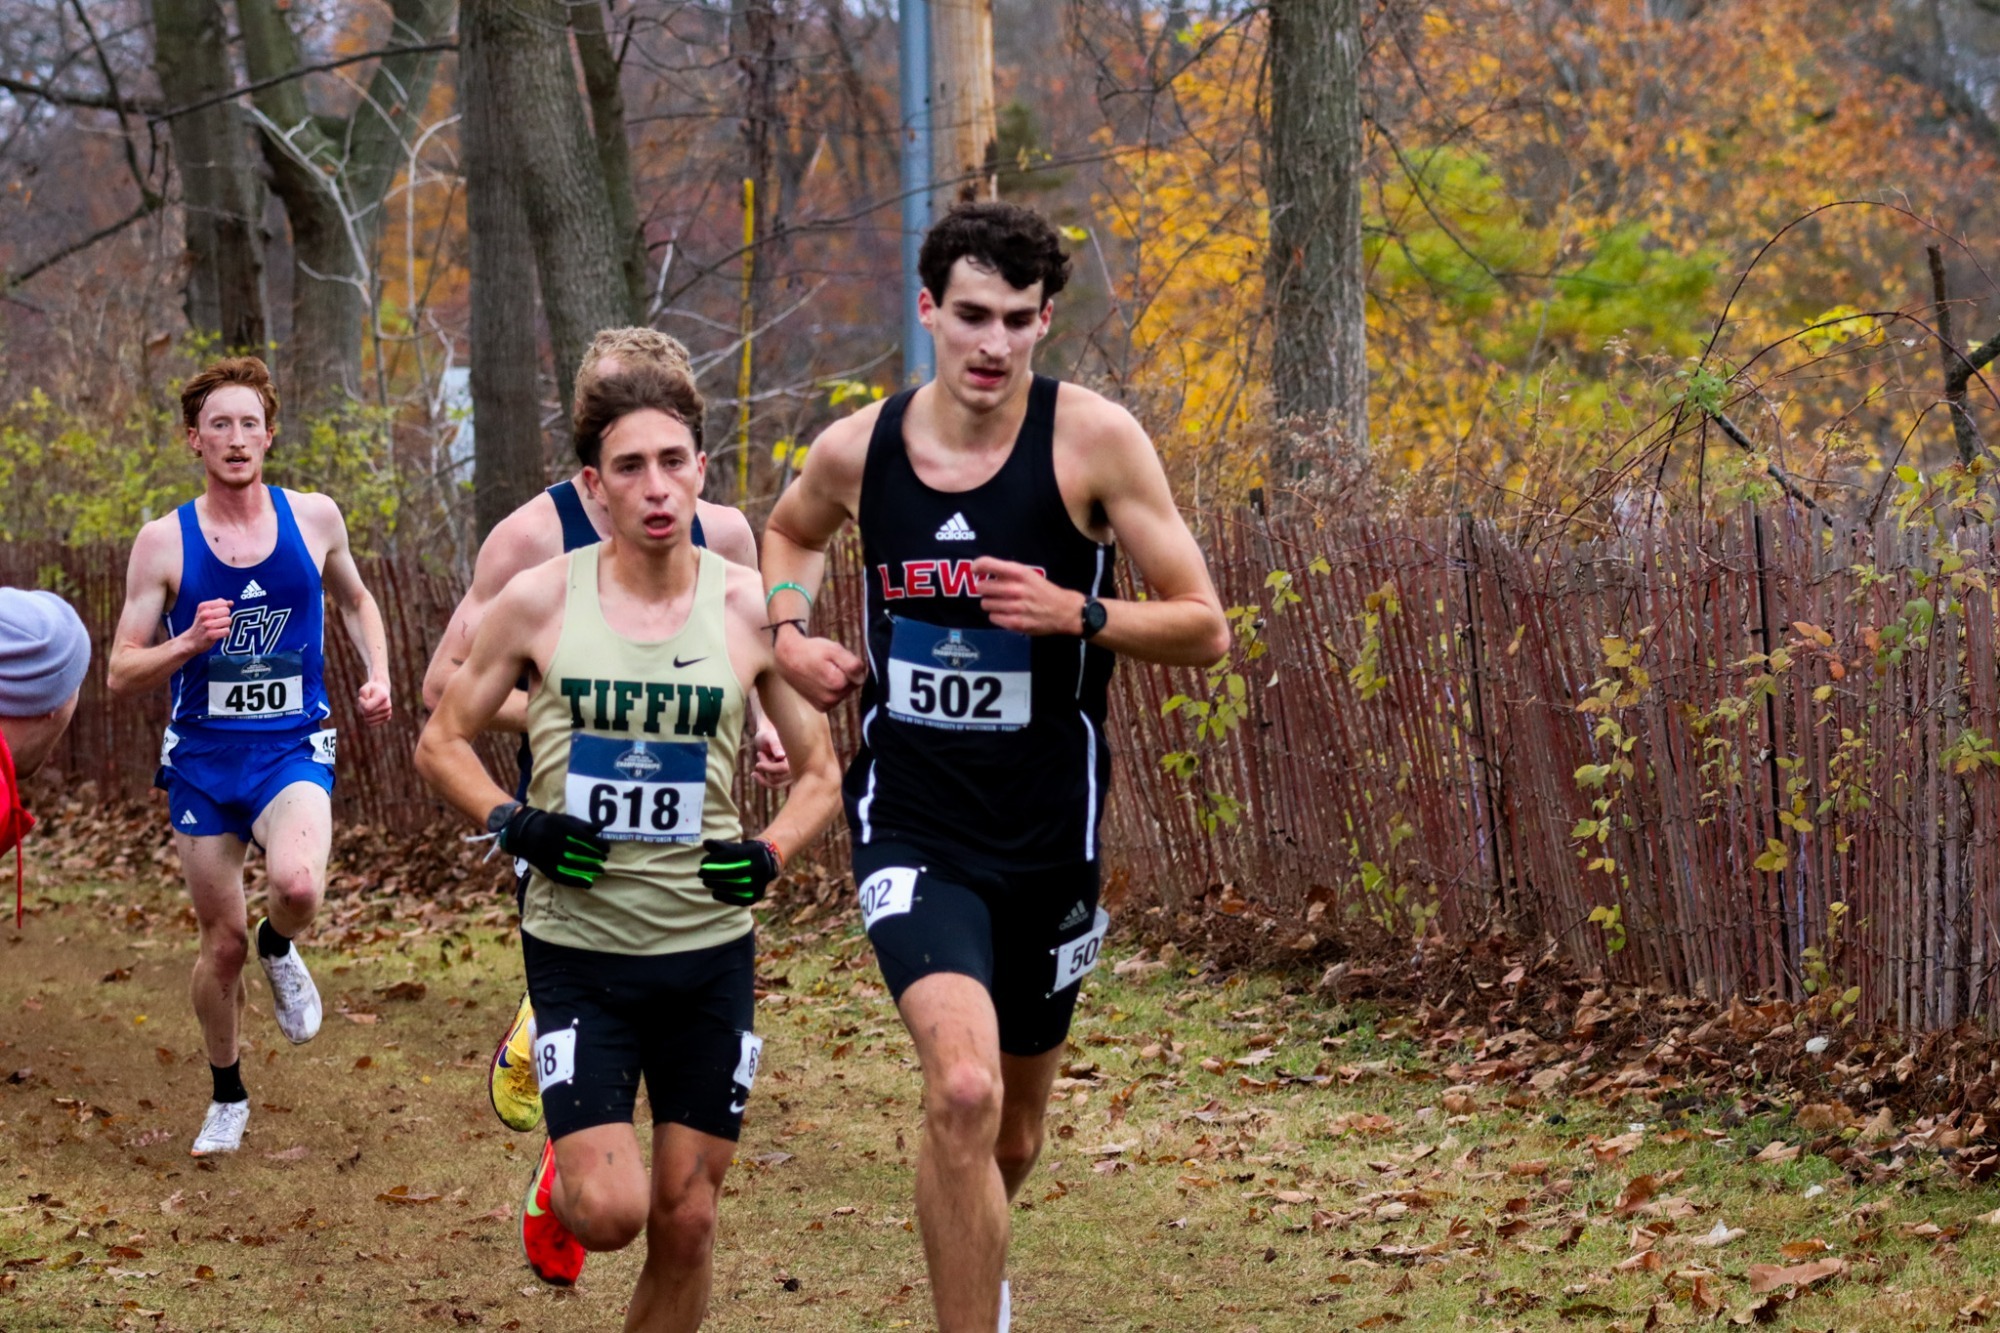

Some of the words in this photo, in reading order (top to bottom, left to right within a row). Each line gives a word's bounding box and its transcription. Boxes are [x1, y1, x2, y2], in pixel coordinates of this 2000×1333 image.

[935, 530, 976, 541] adidas
[240, 590, 267, 600] adidas
[877, 559, 1046, 600] LEW
[221, 605, 292, 656] GV
[225, 682, 287, 712] 450
[561, 678, 724, 737] TIFFIN
[909, 669, 1002, 719] 502
[589, 783, 680, 831] 618
[1070, 937, 1102, 974] 50
